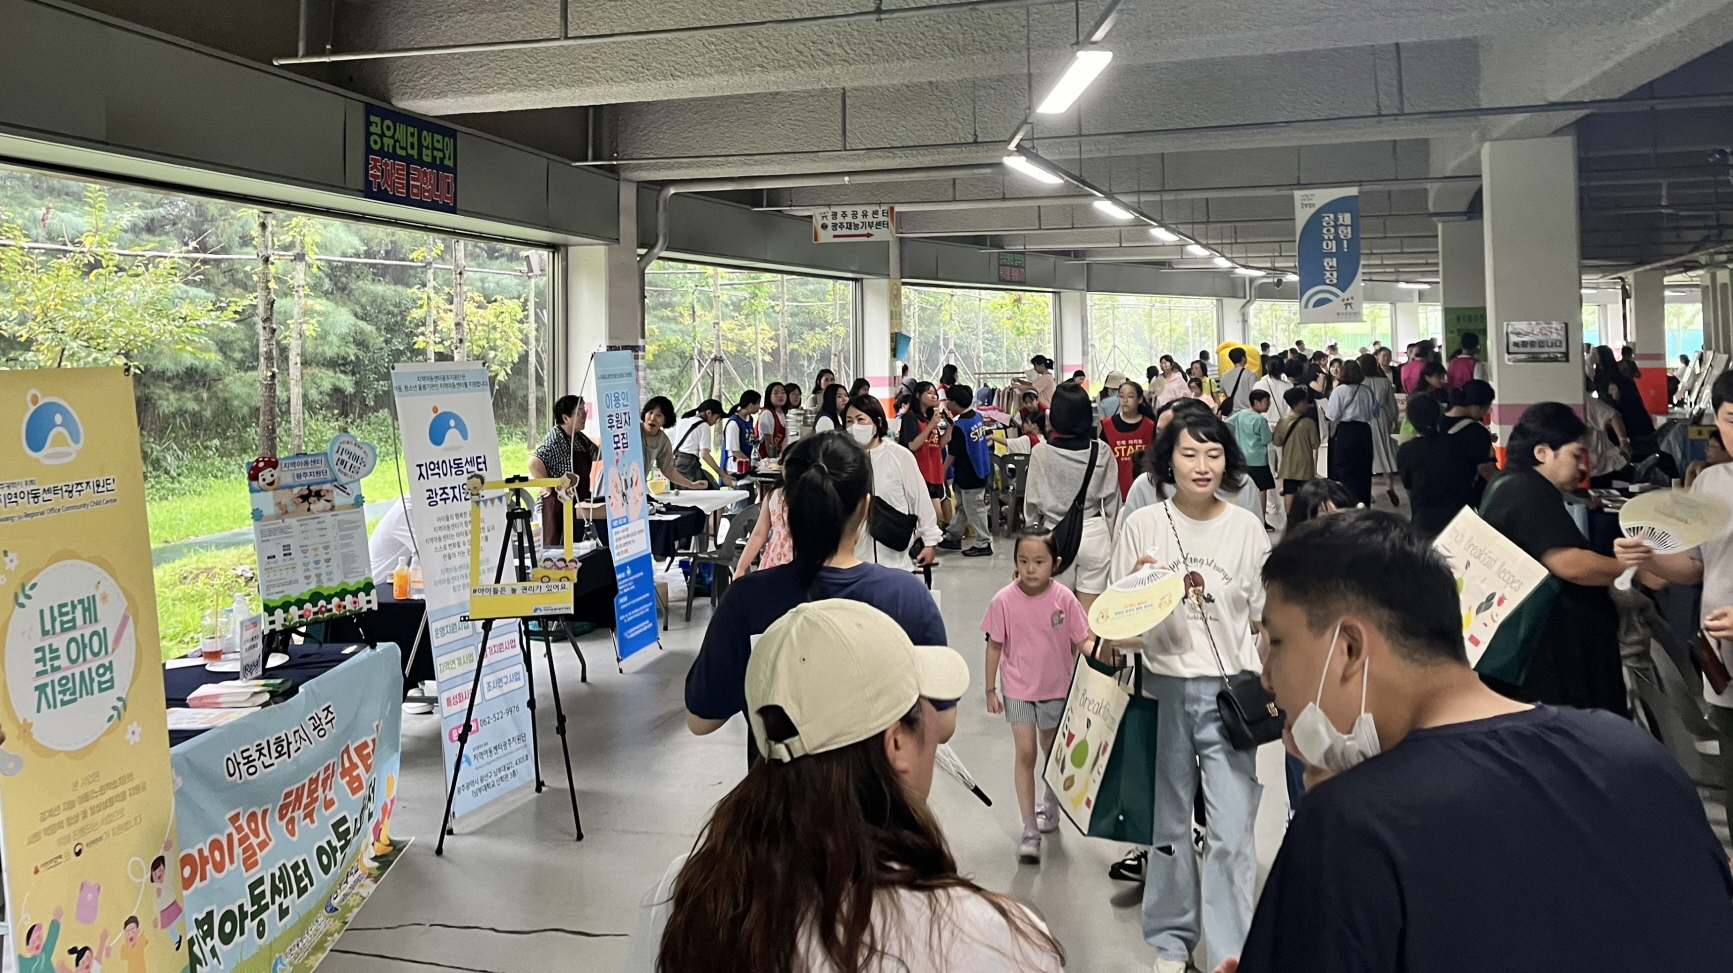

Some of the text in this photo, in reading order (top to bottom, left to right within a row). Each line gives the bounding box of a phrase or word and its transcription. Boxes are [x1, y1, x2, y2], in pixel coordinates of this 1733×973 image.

[369, 115, 454, 168] 공유센터 업무외
[368, 155, 455, 206] 주차를 금합니다
[831, 221, 889, 231] 광주재능기부센터
[1321, 213, 1337, 252] 공유의
[605, 391, 629, 409] 이용인
[607, 411, 631, 430] 후원자
[613, 432, 629, 450] 모집
[283, 458, 323, 469] 지역아동센터
[296, 470, 328, 480] 광주지원단
[416, 454, 488, 481] 지역아동센터
[1463, 535, 1524, 593] Breakfast Recipes
[472, 587, 507, 595] #아이들은
[521, 585, 542, 593] 권리가
[39, 595, 98, 637] 나답게
[66, 627, 109, 665] 아이
[439, 652, 475, 674] 지역연계사업
[34, 660, 115, 713] 지원사업
[486, 671, 521, 692] 조사연구사업
[309, 705, 336, 736] 광주
[480, 704, 520, 728] 062-522-9976
[180, 808, 272, 891] 아이들의
[277, 762, 336, 838] 행복한
